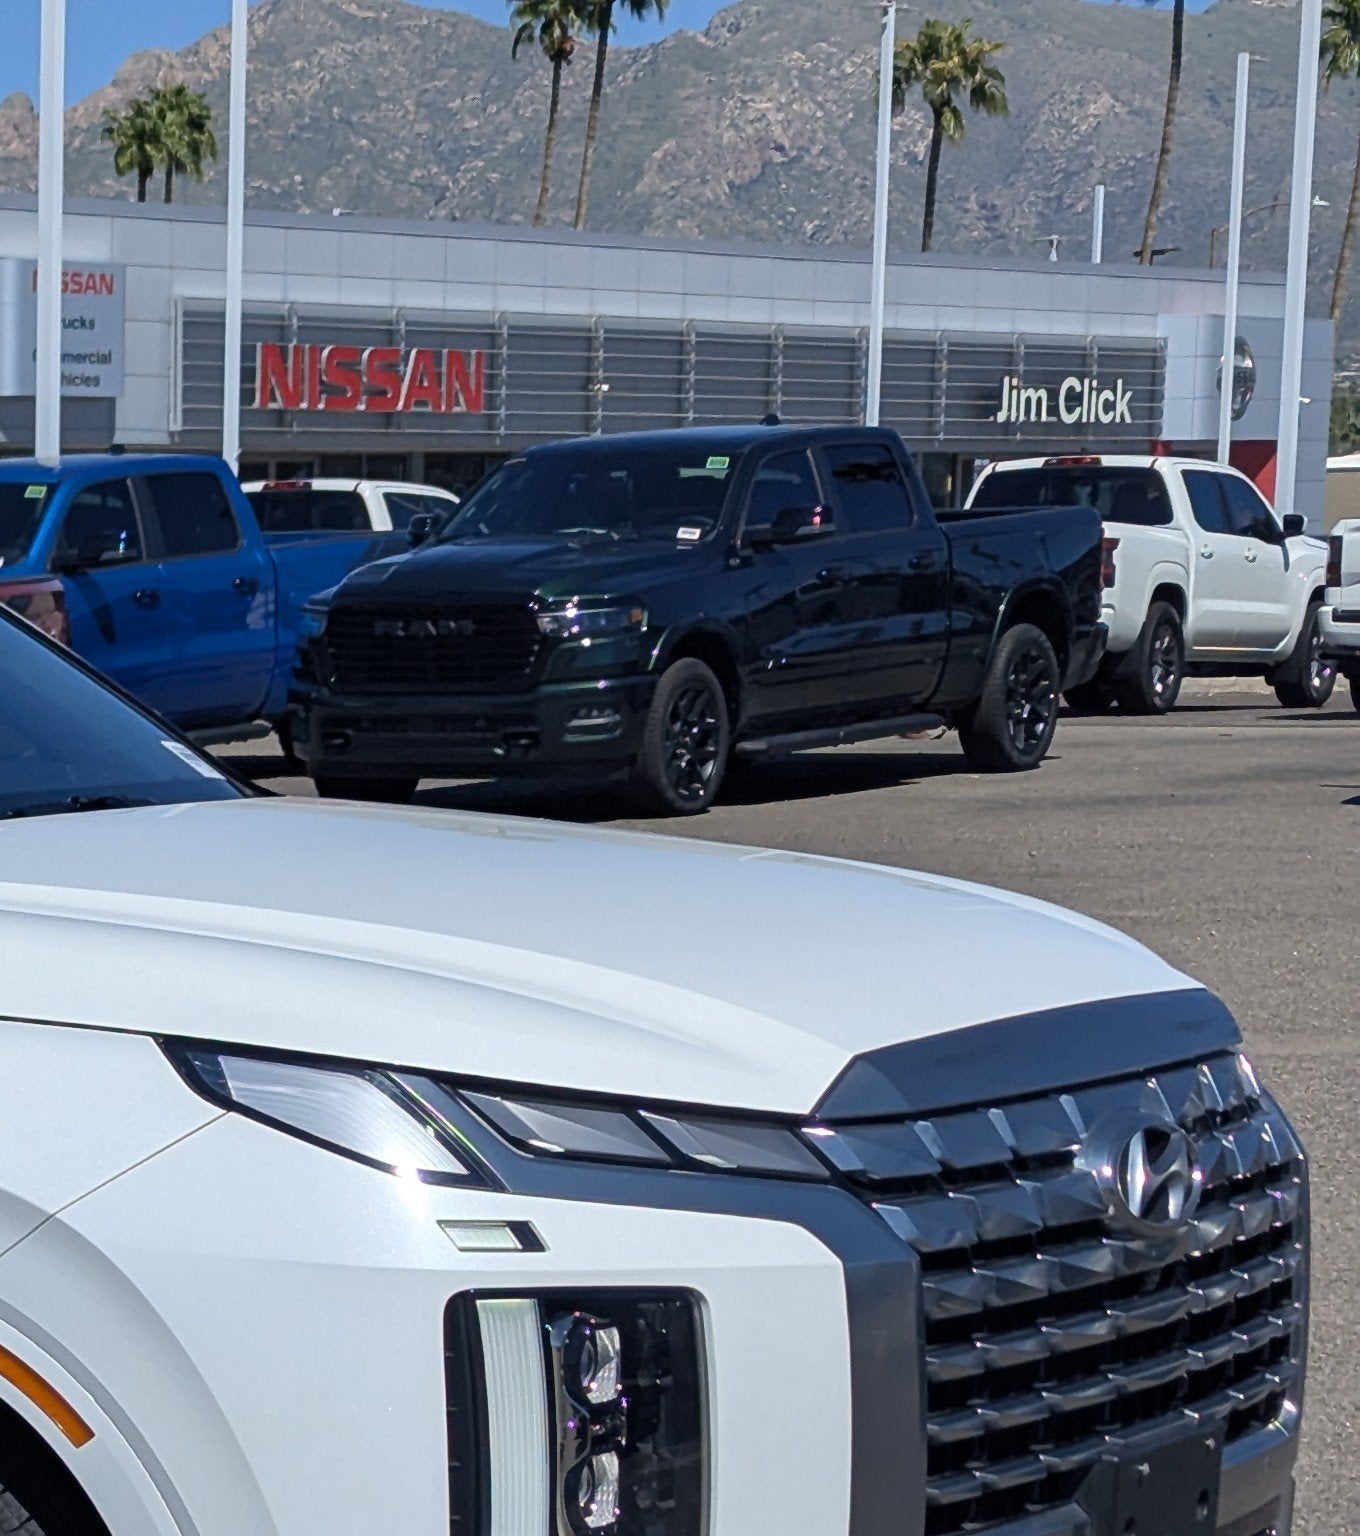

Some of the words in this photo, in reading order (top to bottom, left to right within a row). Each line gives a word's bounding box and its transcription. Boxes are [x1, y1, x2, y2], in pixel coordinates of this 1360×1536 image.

[32, 268, 115, 295] SSAN
[254, 342, 484, 412] NISSAN
[996, 376, 1048, 423] Jim
[1059, 376, 1133, 424] Click
